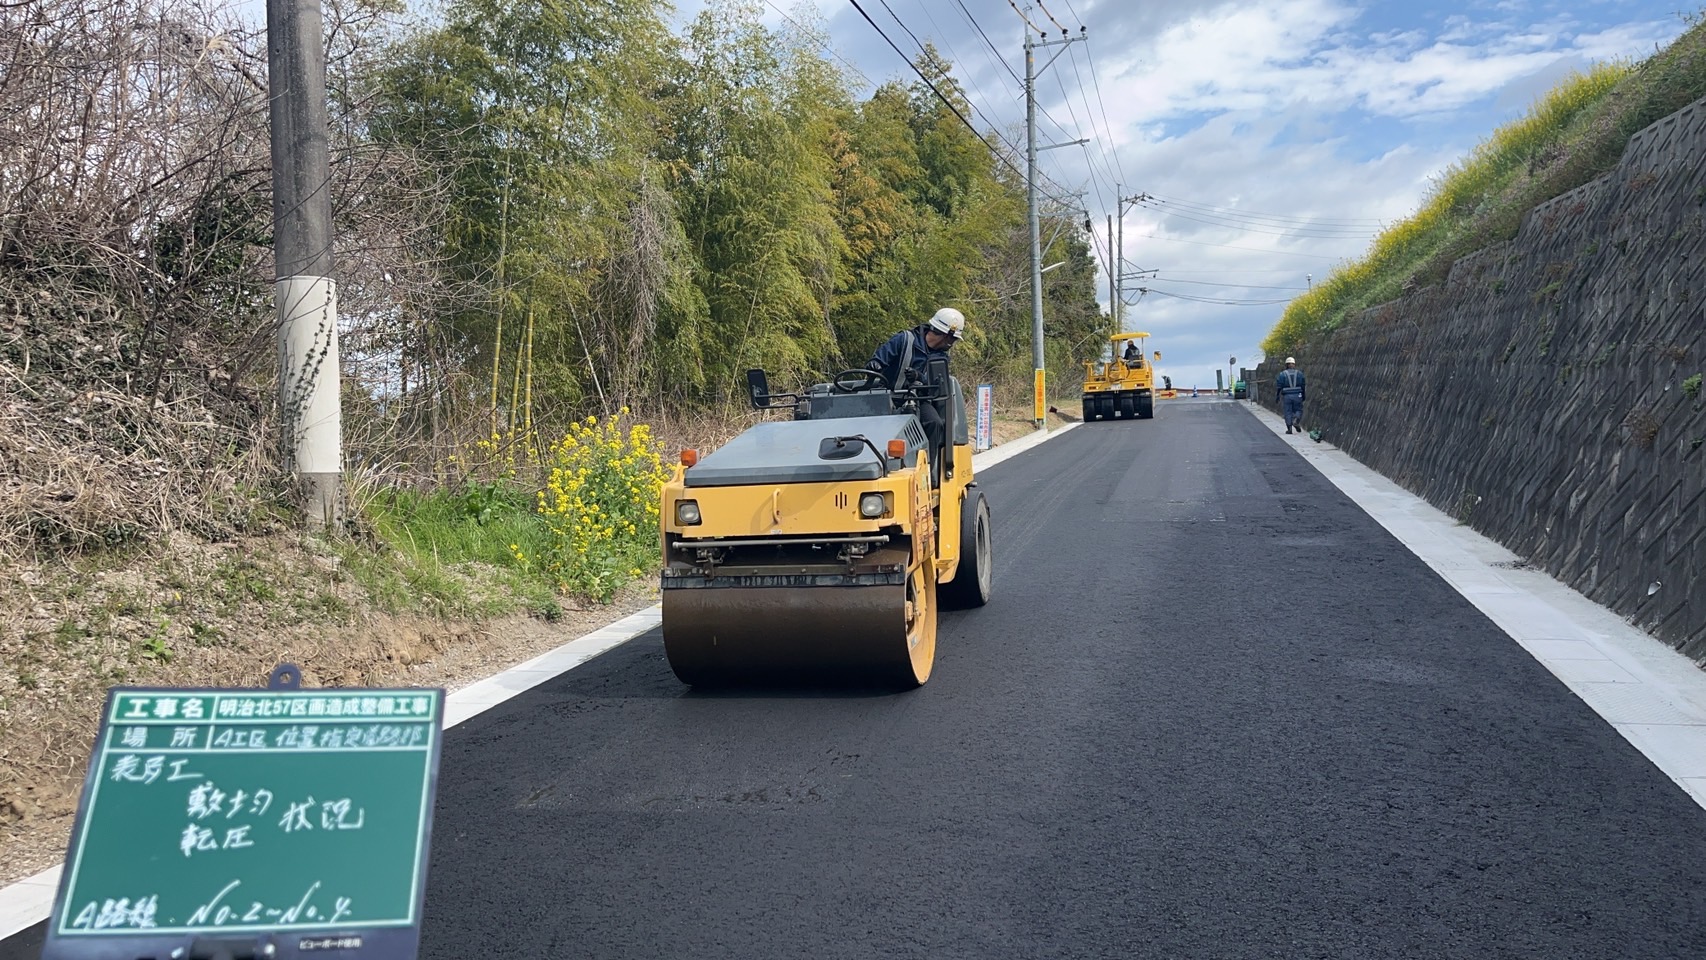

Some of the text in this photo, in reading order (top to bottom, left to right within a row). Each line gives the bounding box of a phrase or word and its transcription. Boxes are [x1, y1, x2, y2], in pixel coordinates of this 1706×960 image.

[124, 698, 204, 718] 工事名
[218, 697, 428, 716] 明治北57区画造成整備工事
